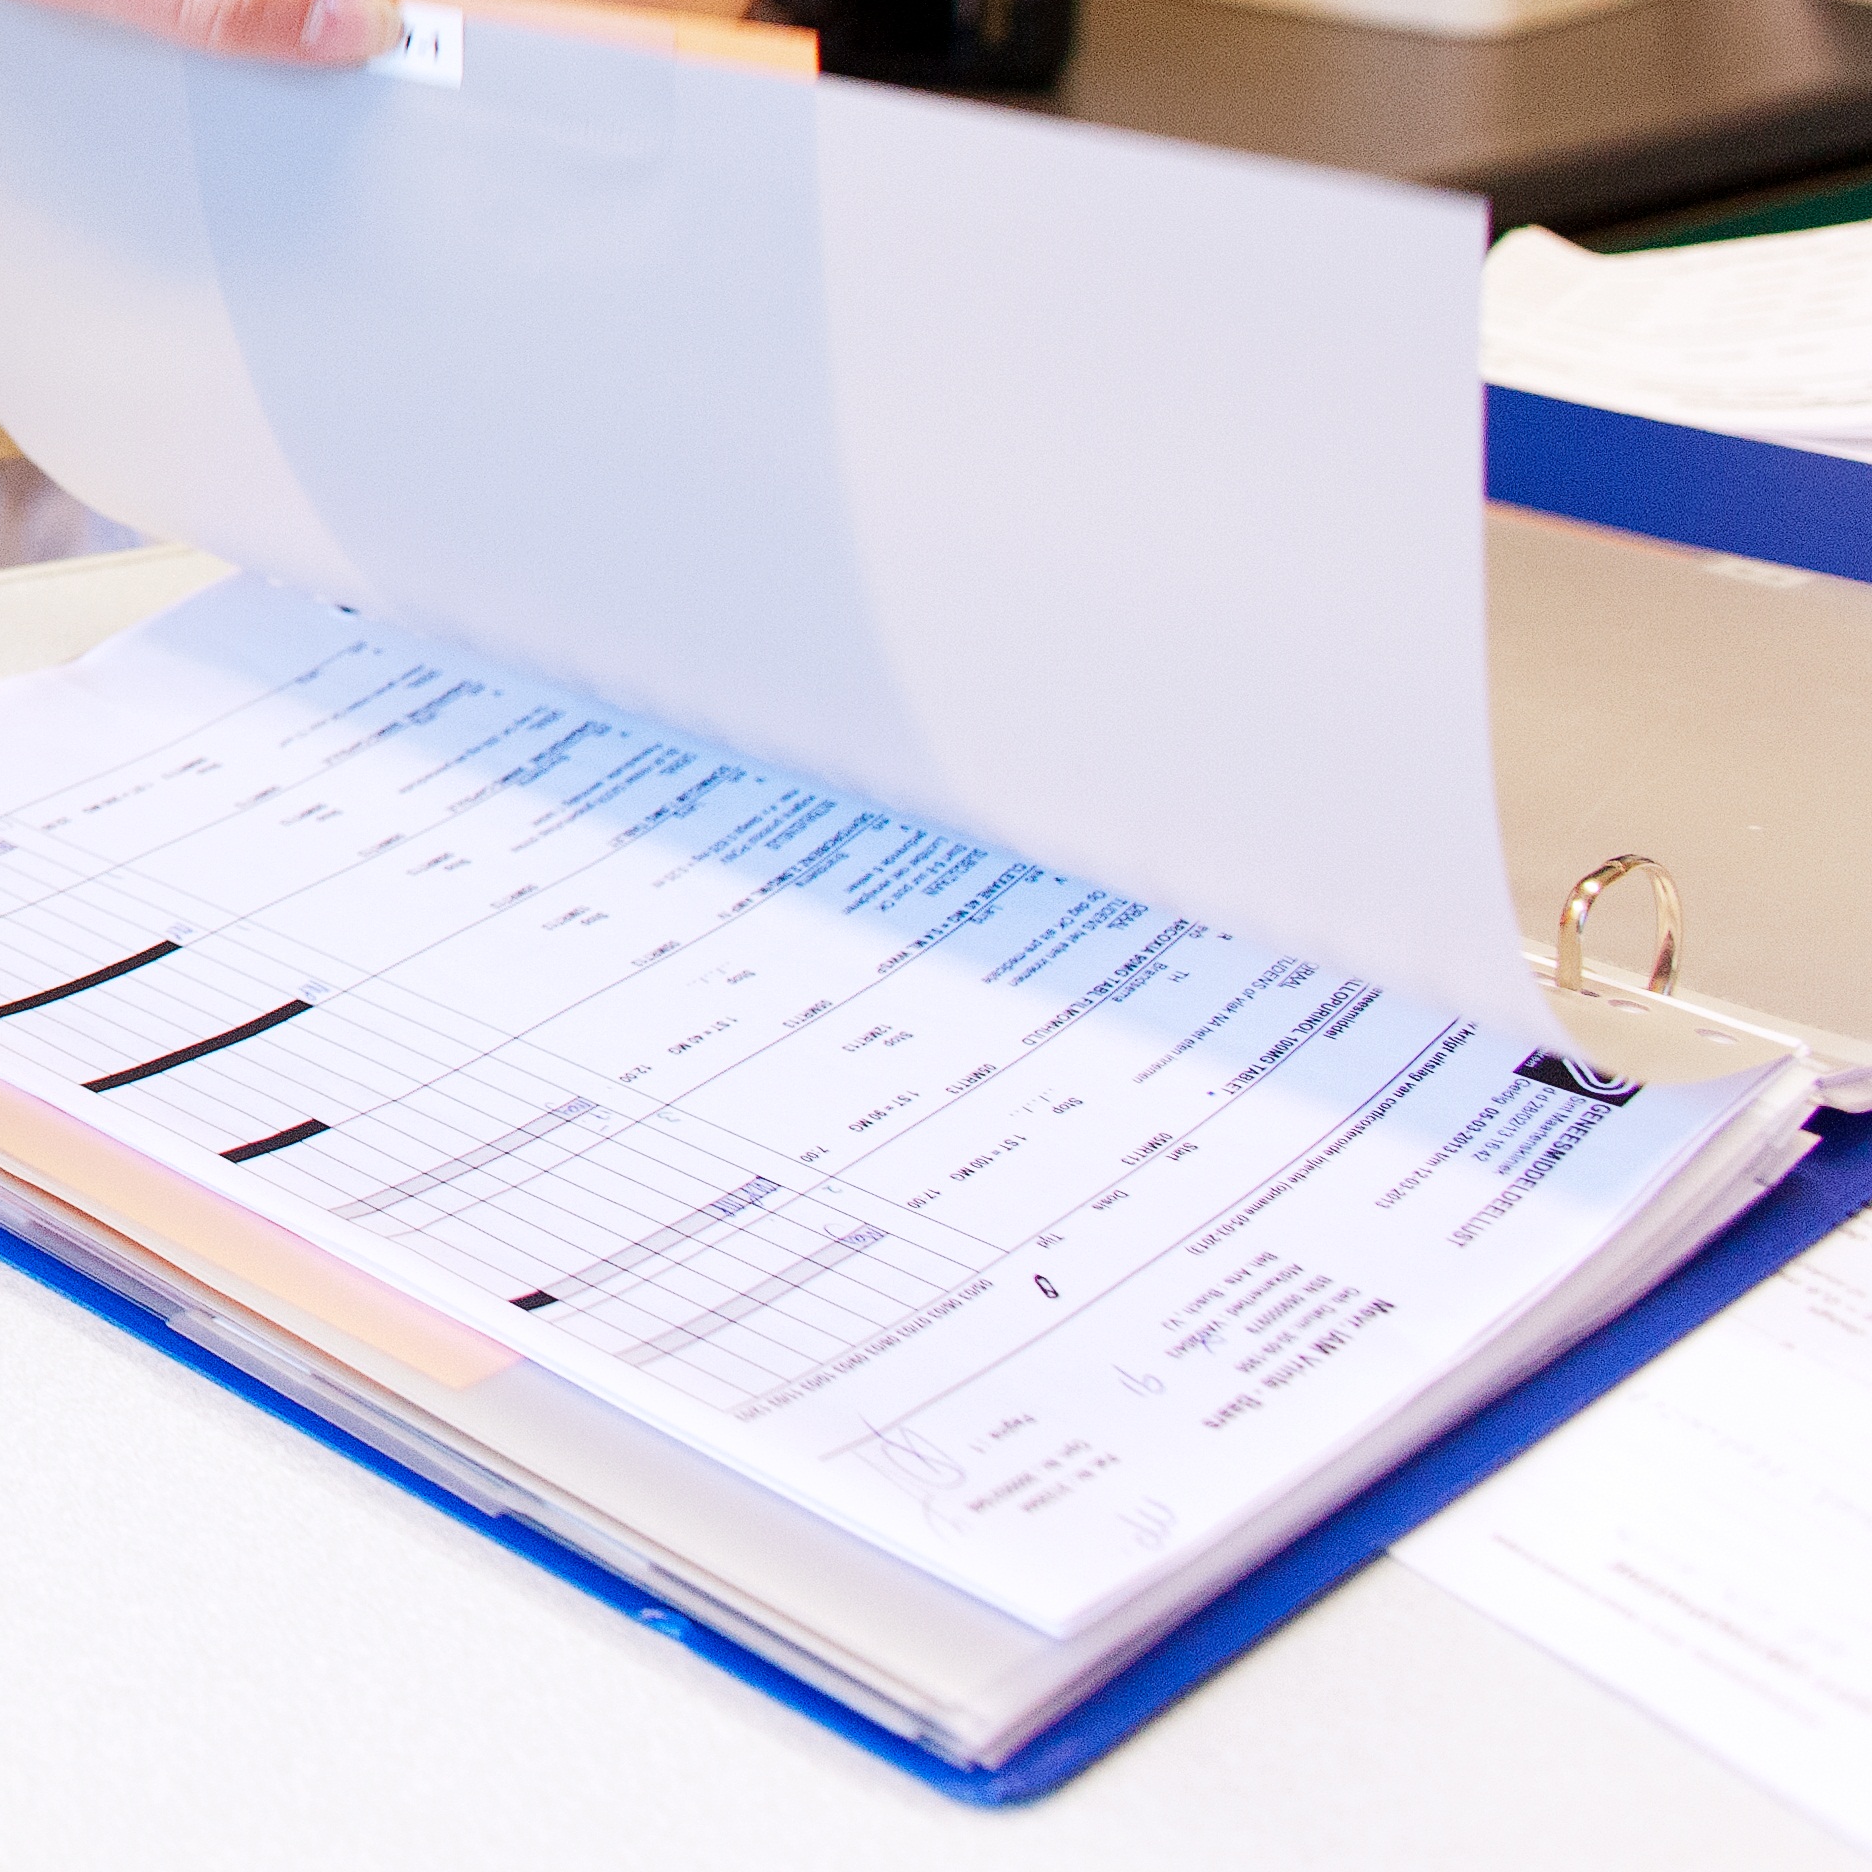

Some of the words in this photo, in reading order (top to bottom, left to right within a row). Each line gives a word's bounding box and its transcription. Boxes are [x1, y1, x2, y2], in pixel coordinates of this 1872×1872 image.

[1322, 987, 1384, 1040] eneesmiddel
[1258, 1035, 1298, 1064] 100MG
[1440, 1027, 1476, 1054] krijgt
[1222, 1063, 1266, 1095] TABLET
[1392, 1081, 1416, 1098] van
[1442, 1107, 1500, 1153] 05-03-2013
[1165, 1142, 1198, 1162] Start
[1374, 1167, 1433, 1209] 12-03-2013
